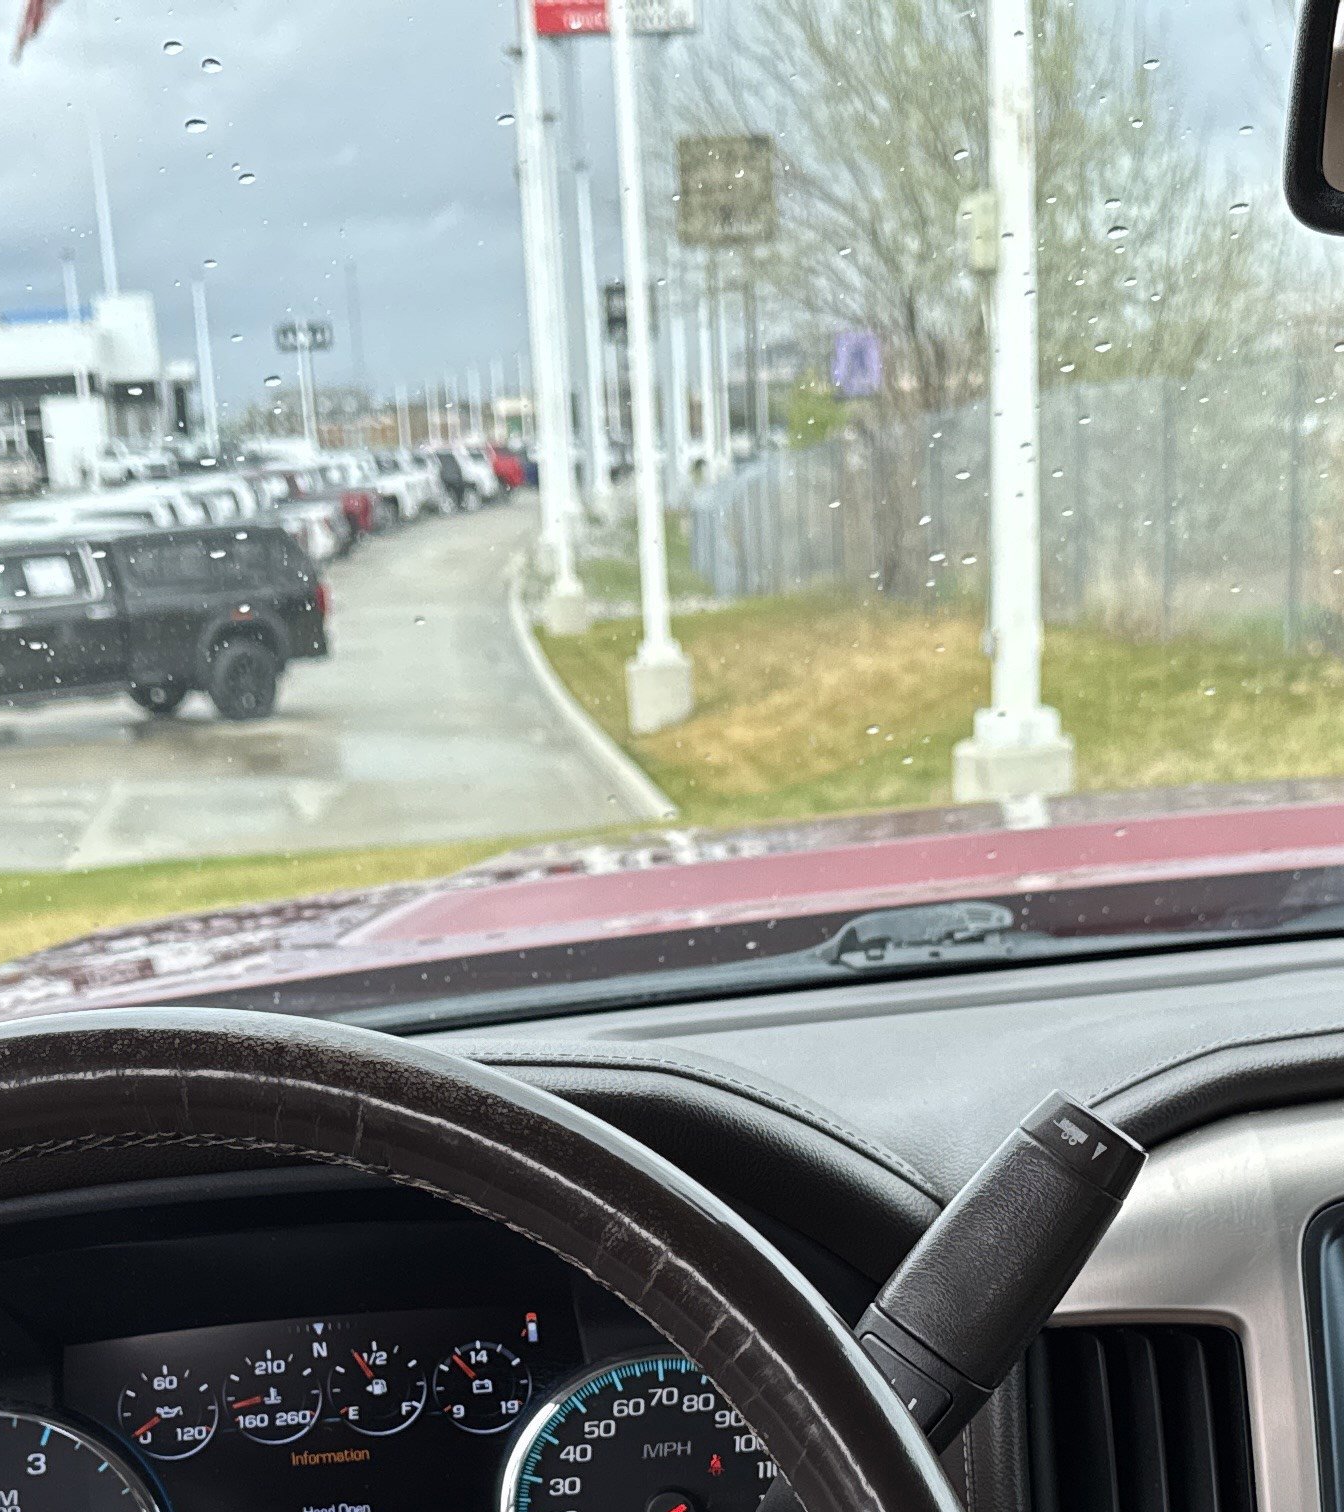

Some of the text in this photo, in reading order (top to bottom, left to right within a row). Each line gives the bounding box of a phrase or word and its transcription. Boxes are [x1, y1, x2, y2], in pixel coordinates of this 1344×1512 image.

[311, 1341, 328, 1359] N
[469, 1350, 489, 1365] 14
[254, 1358, 286, 1376] 210
[152, 1375, 178, 1392] 60
[648, 1387, 679, 1406] 70
[682, 1393, 715, 1413] 80
[347, 1406, 360, 1422] E
[401, 1401, 414, 1417] F
[452, 1405, 465, 1420] 9
[500, 1399, 519, 1416] 19
[612, 1397, 645, 1417] 60
[238, 1413, 269, 1430] 160
[275, 1409, 312, 1427] 260
[176, 1426, 207, 1443] 120
[583, 1419, 616, 1439] 50
[291, 1447, 371, 1467] Information
[559, 1444, 592, 1463] 40
[641, 1440, 692, 1461] MPH
[26, 1452, 47, 1476] 3
[549, 1476, 581, 1497] 30
